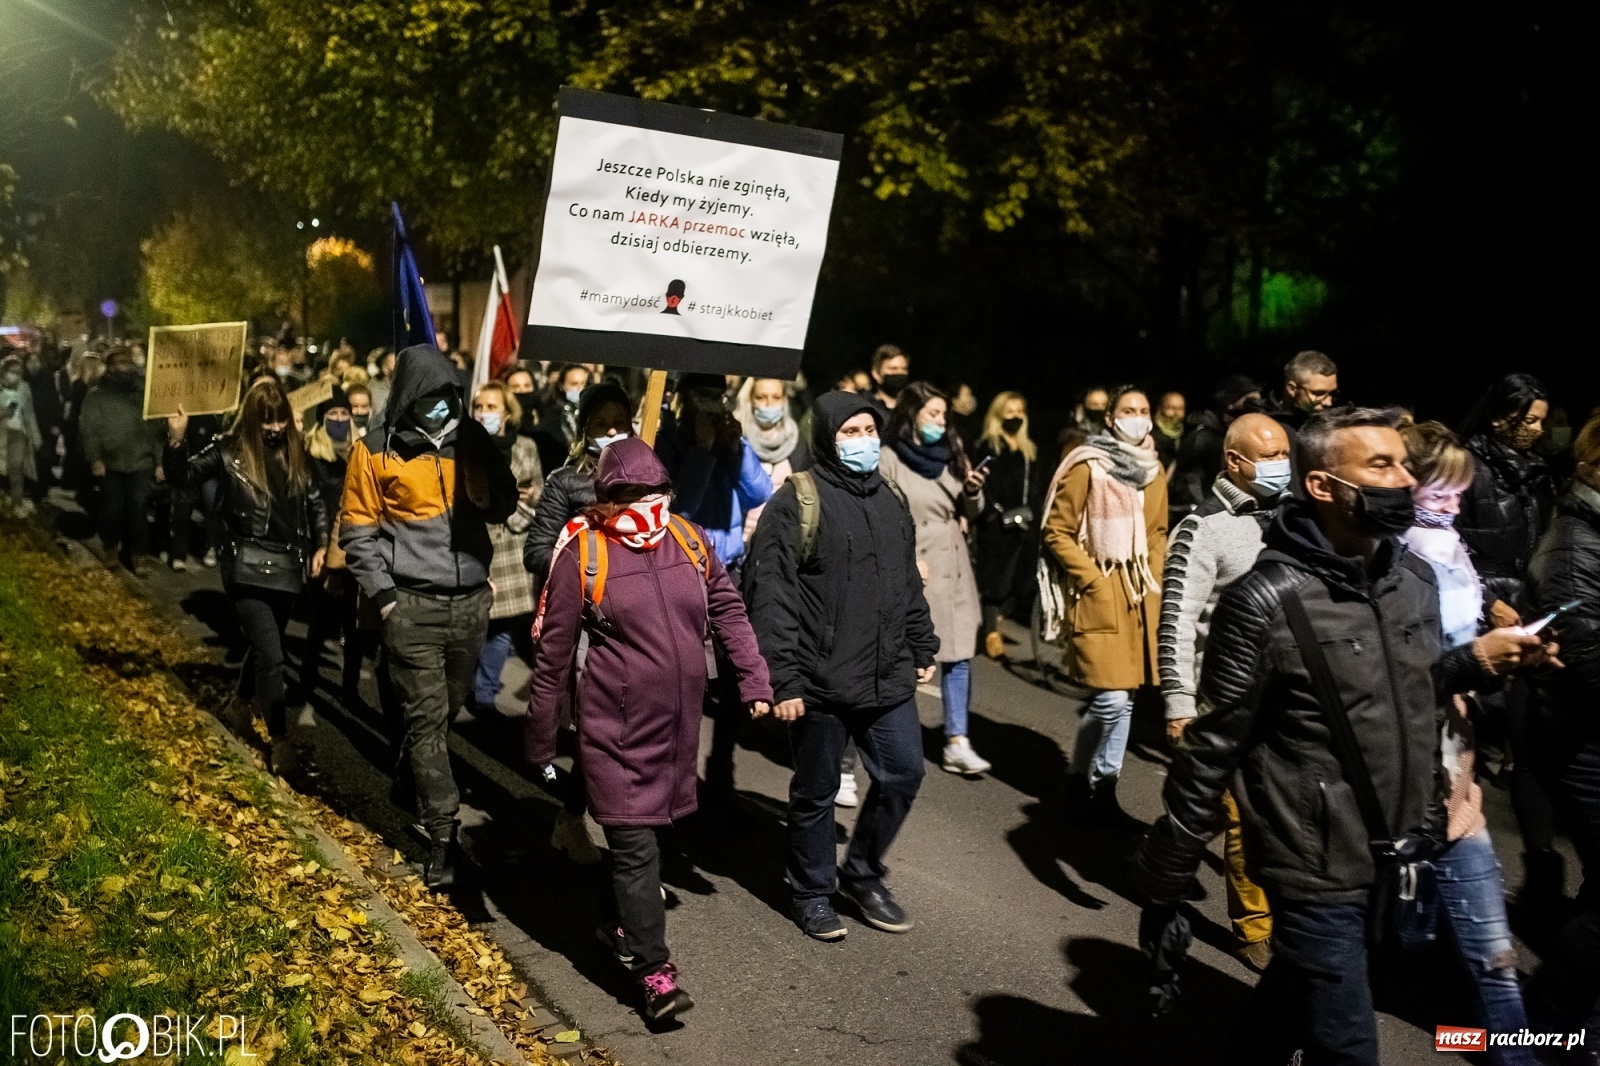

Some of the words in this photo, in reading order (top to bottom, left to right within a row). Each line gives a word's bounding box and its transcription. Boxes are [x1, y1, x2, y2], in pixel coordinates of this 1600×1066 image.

[597, 159, 653, 179] Jeszcze
[656, 167, 705, 188] Polska
[709, 175, 730, 190] nie
[733, 180, 790, 203] zginęła,
[626, 186, 669, 208] Kiedy
[673, 196, 697, 212] my
[699, 196, 754, 219] żyjemy.
[569, 203, 589, 218] Co
[592, 208, 624, 222] nam
[628, 210, 679, 231] JARKA
[683, 220, 746, 239] przemoc
[750, 230, 800, 250] wzięła,
[611, 230, 660, 254] dzisiaj
[663, 238, 752, 263] odbierzemy.
[580, 290, 660, 312] #mamydość
[688, 302, 697, 312] #
[700, 304, 774, 322] strajkkobiet
